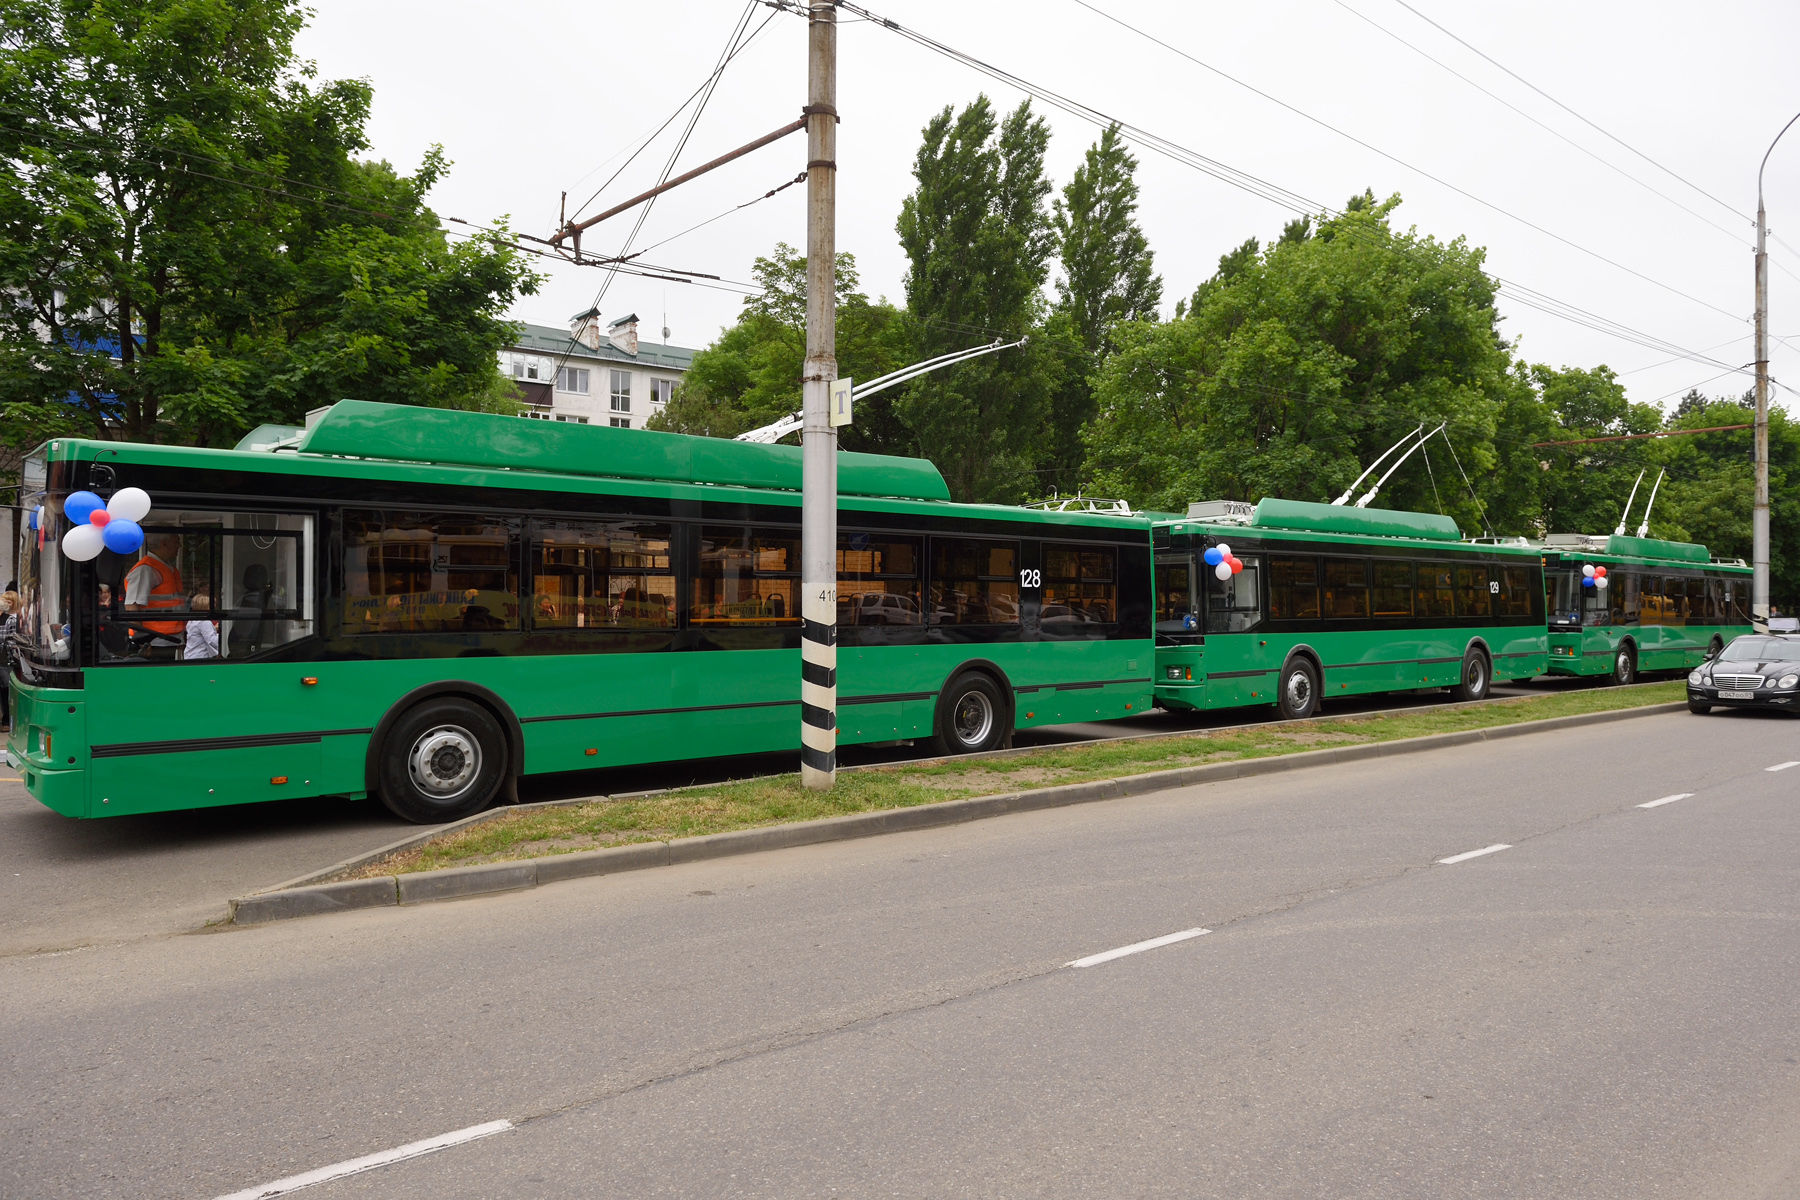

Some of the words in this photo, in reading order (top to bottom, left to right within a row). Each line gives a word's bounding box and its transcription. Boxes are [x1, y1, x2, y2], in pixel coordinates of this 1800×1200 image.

[835, 390, 847, 415] Т
[1020, 569, 1041, 588] 128
[1490, 581, 1500, 594] 129
